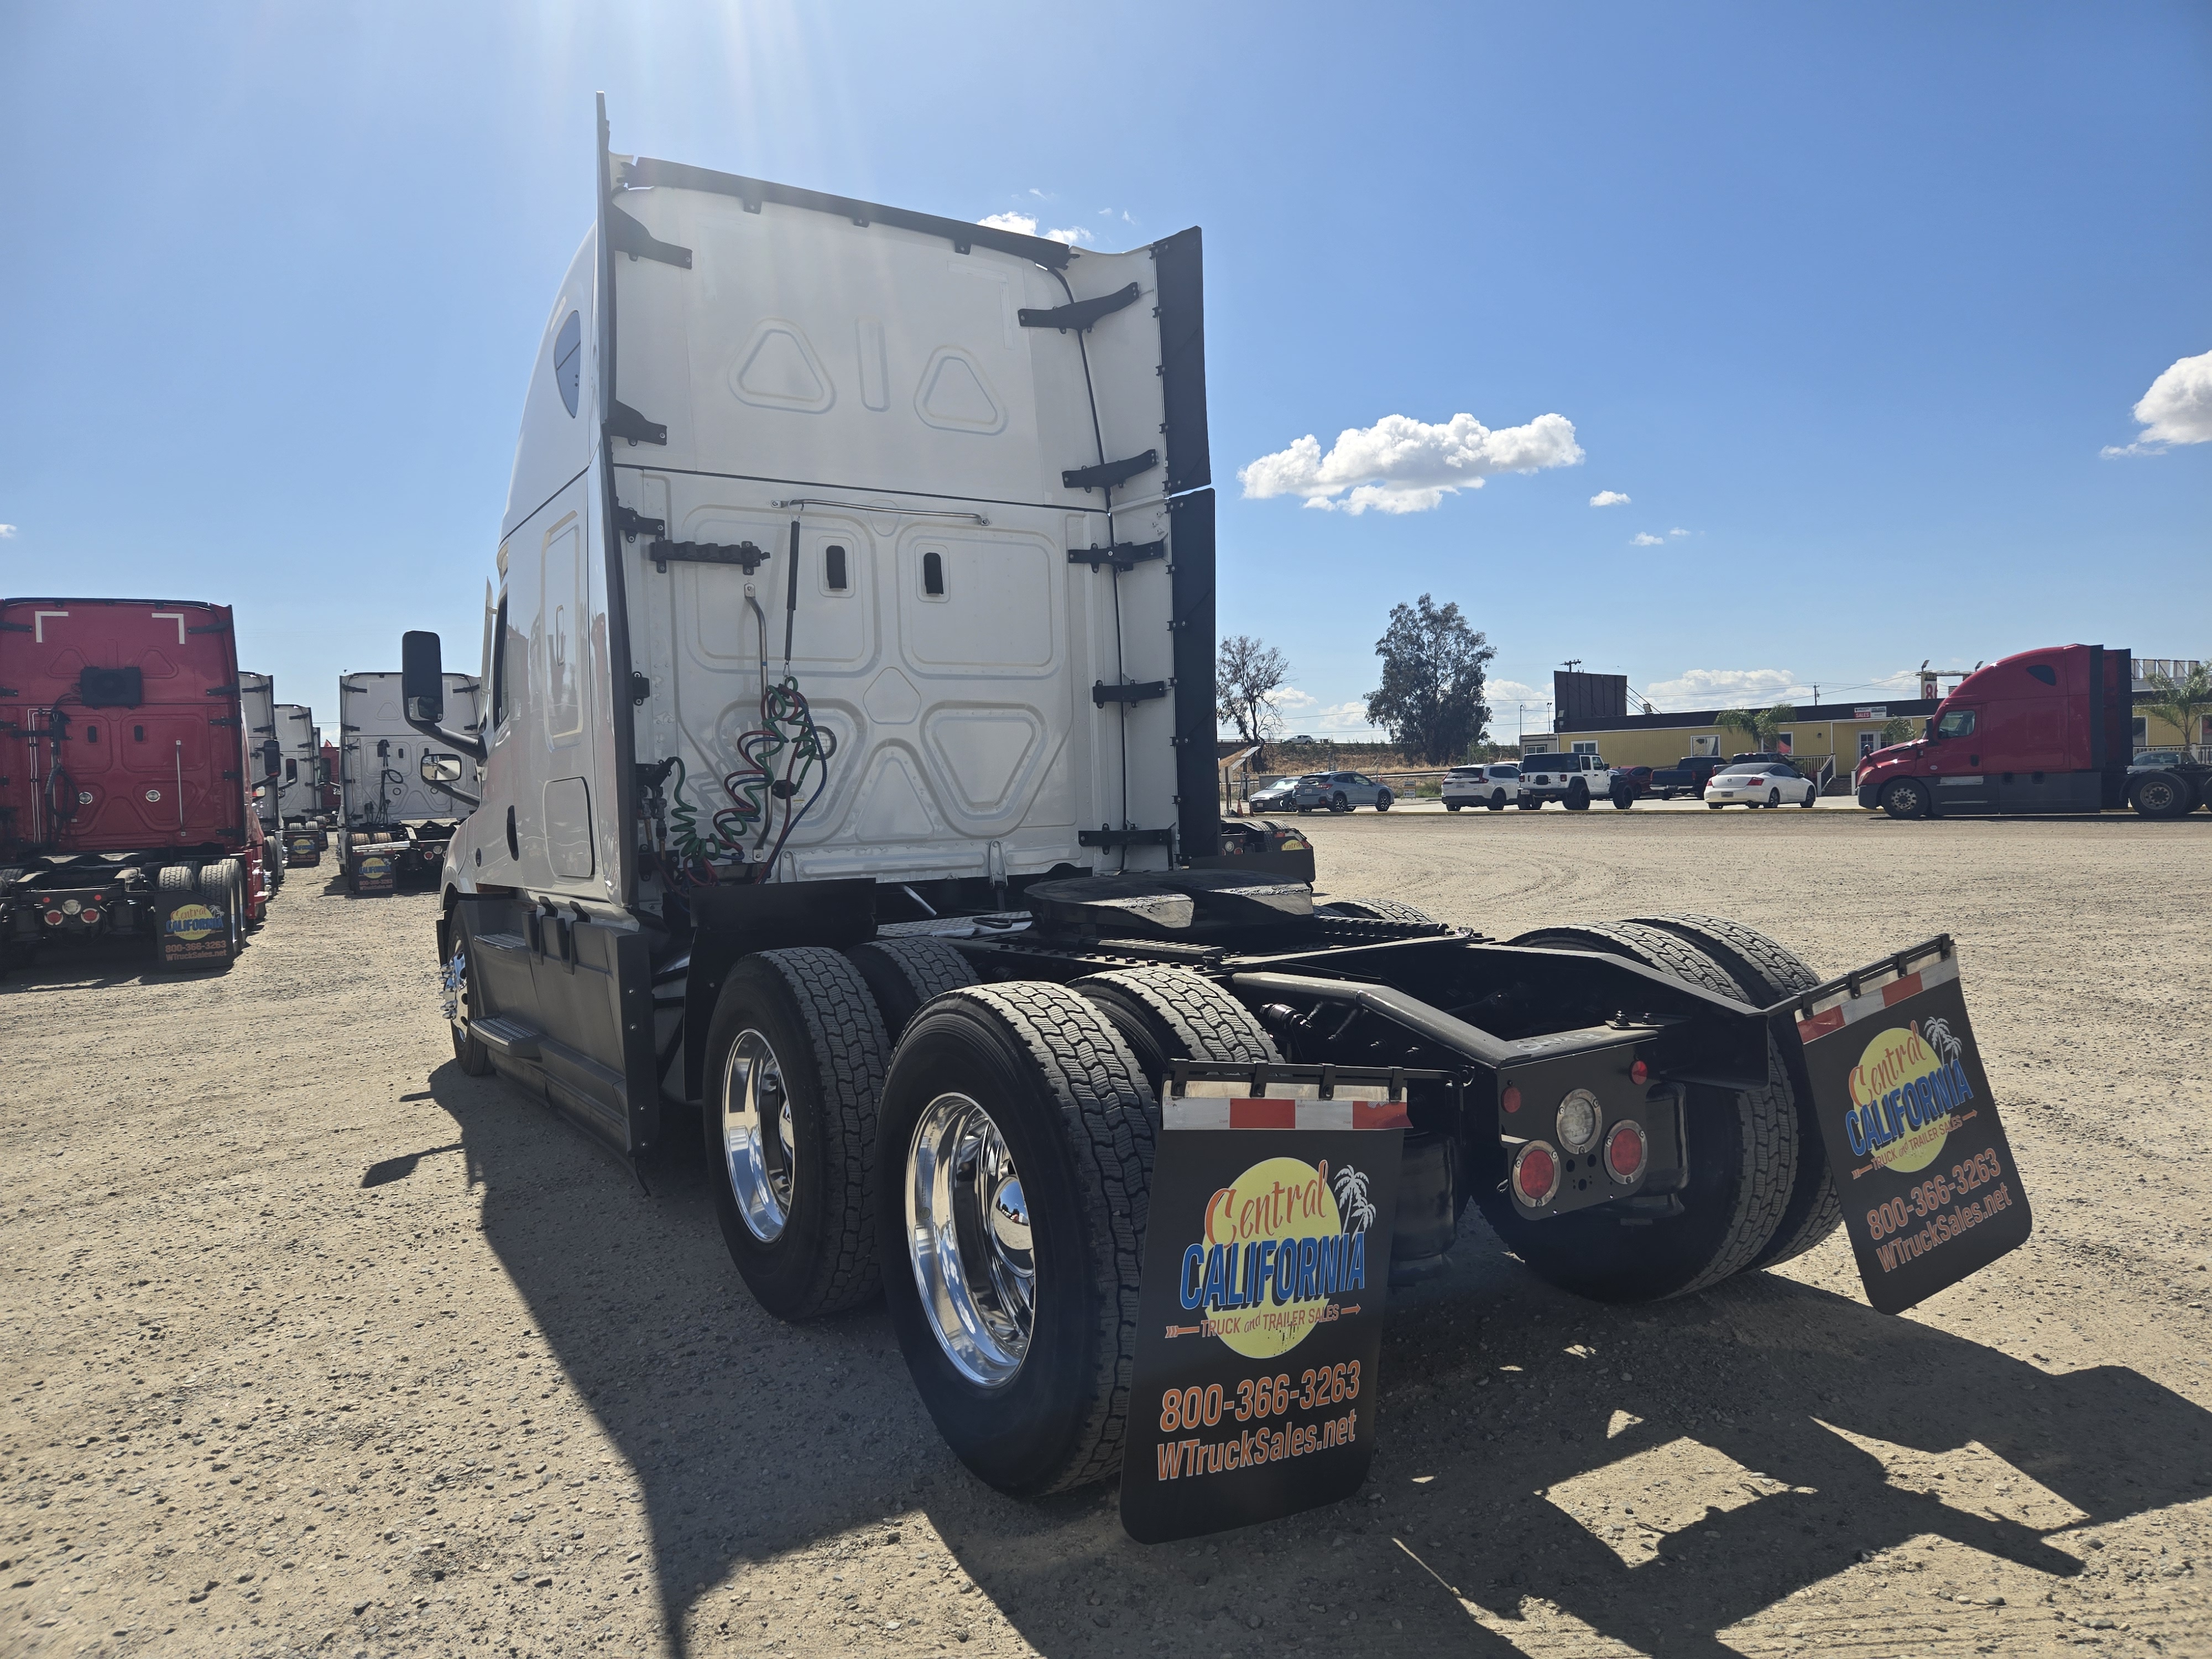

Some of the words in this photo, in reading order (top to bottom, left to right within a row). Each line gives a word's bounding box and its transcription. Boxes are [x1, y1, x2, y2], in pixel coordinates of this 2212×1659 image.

[165, 940, 226, 953] 800-366-3263
[166, 917, 223, 933] CALIFORNIA
[170, 904, 207, 921] Central
[166, 950, 227, 961] WTruckSales.net
[1848, 1020, 1927, 1108] Central
[1845, 1058, 1974, 1156] CALIFORNIA
[1871, 1148, 1898, 1171] TRUCK
[1898, 1140, 1909, 1158] and
[1908, 1128, 1940, 1150] TRAILER
[1939, 1115, 1963, 1137] SALES
[1205, 1159, 1328, 1249] Central
[1866, 1148, 2001, 1240] 800-366-3263
[1876, 1183, 2012, 1272] WTruckSales.net
[1180, 1231, 1365, 1310] CALIFORNIA
[1201, 1316, 1240, 1338] TRUCK
[1244, 1310, 1261, 1334] and
[1263, 1308, 1306, 1331] TRAILER
[1307, 1304, 1339, 1325] SALES
[1160, 1360, 1360, 1432] 800-366-3263
[1157, 1408, 1357, 1481] WTruckSales.net
